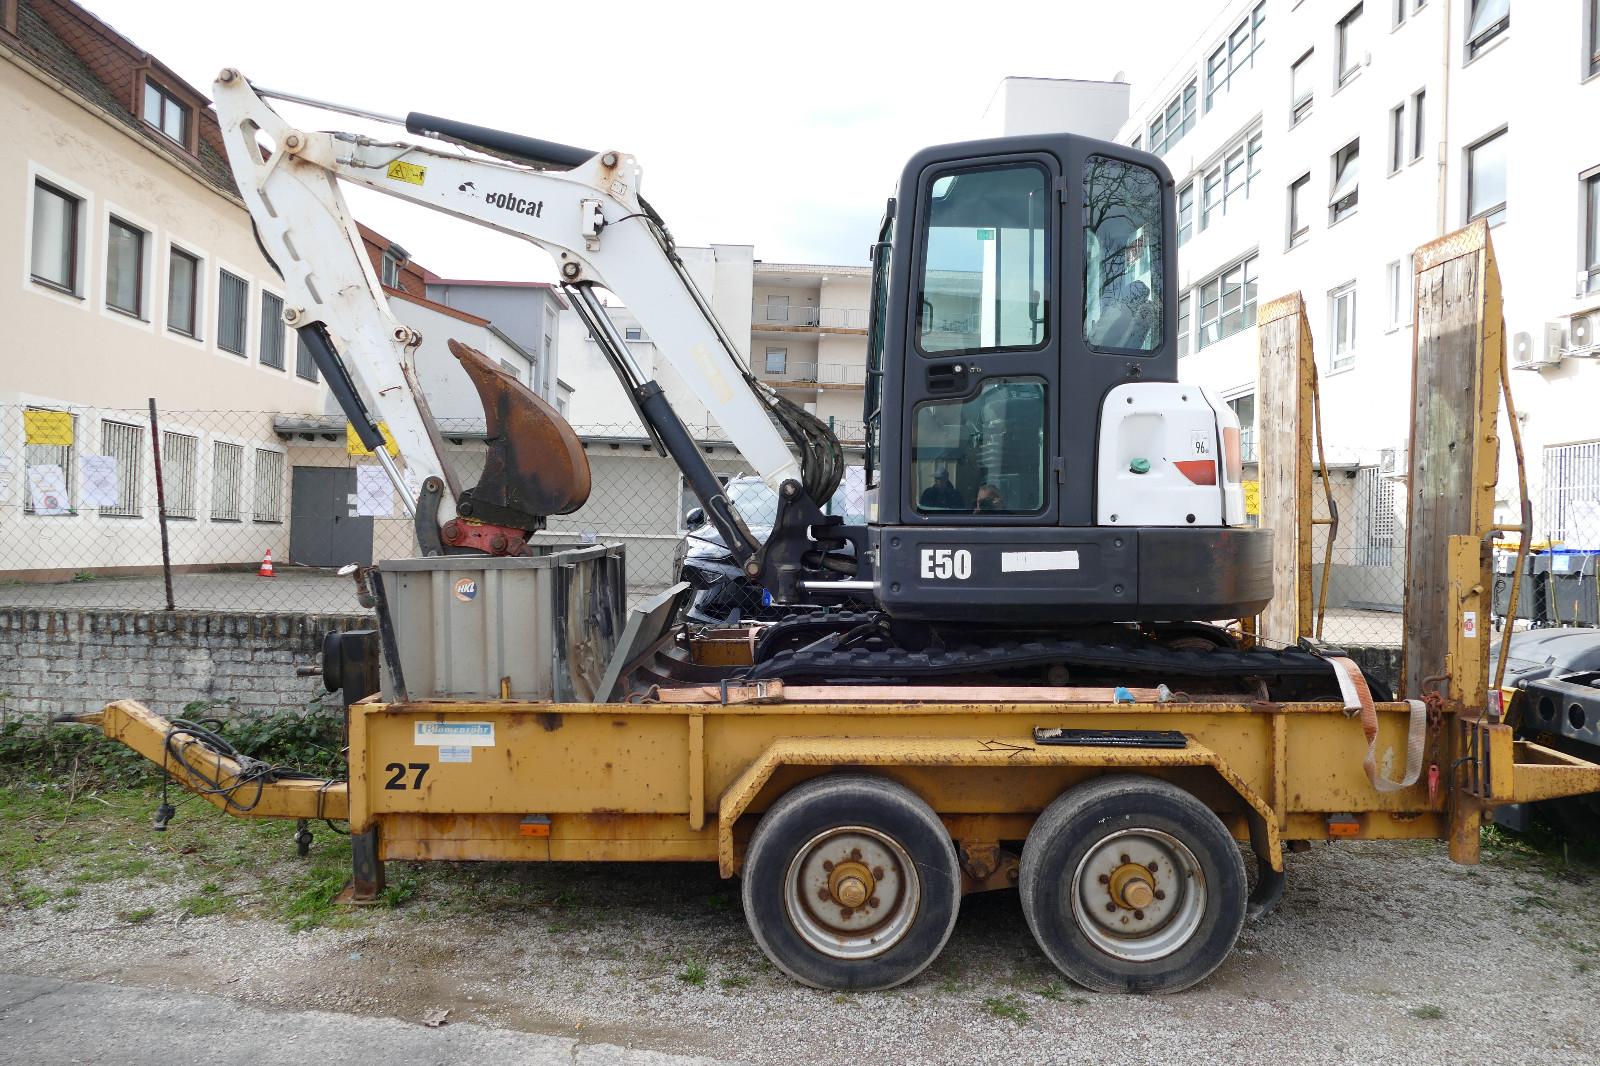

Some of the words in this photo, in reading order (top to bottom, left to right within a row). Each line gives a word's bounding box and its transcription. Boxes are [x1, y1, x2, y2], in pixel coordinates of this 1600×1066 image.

[485, 192, 544, 218] Bobcat
[1195, 441, 1205, 454] 96
[920, 549, 972, 580] E50
[385, 763, 430, 790] 27
